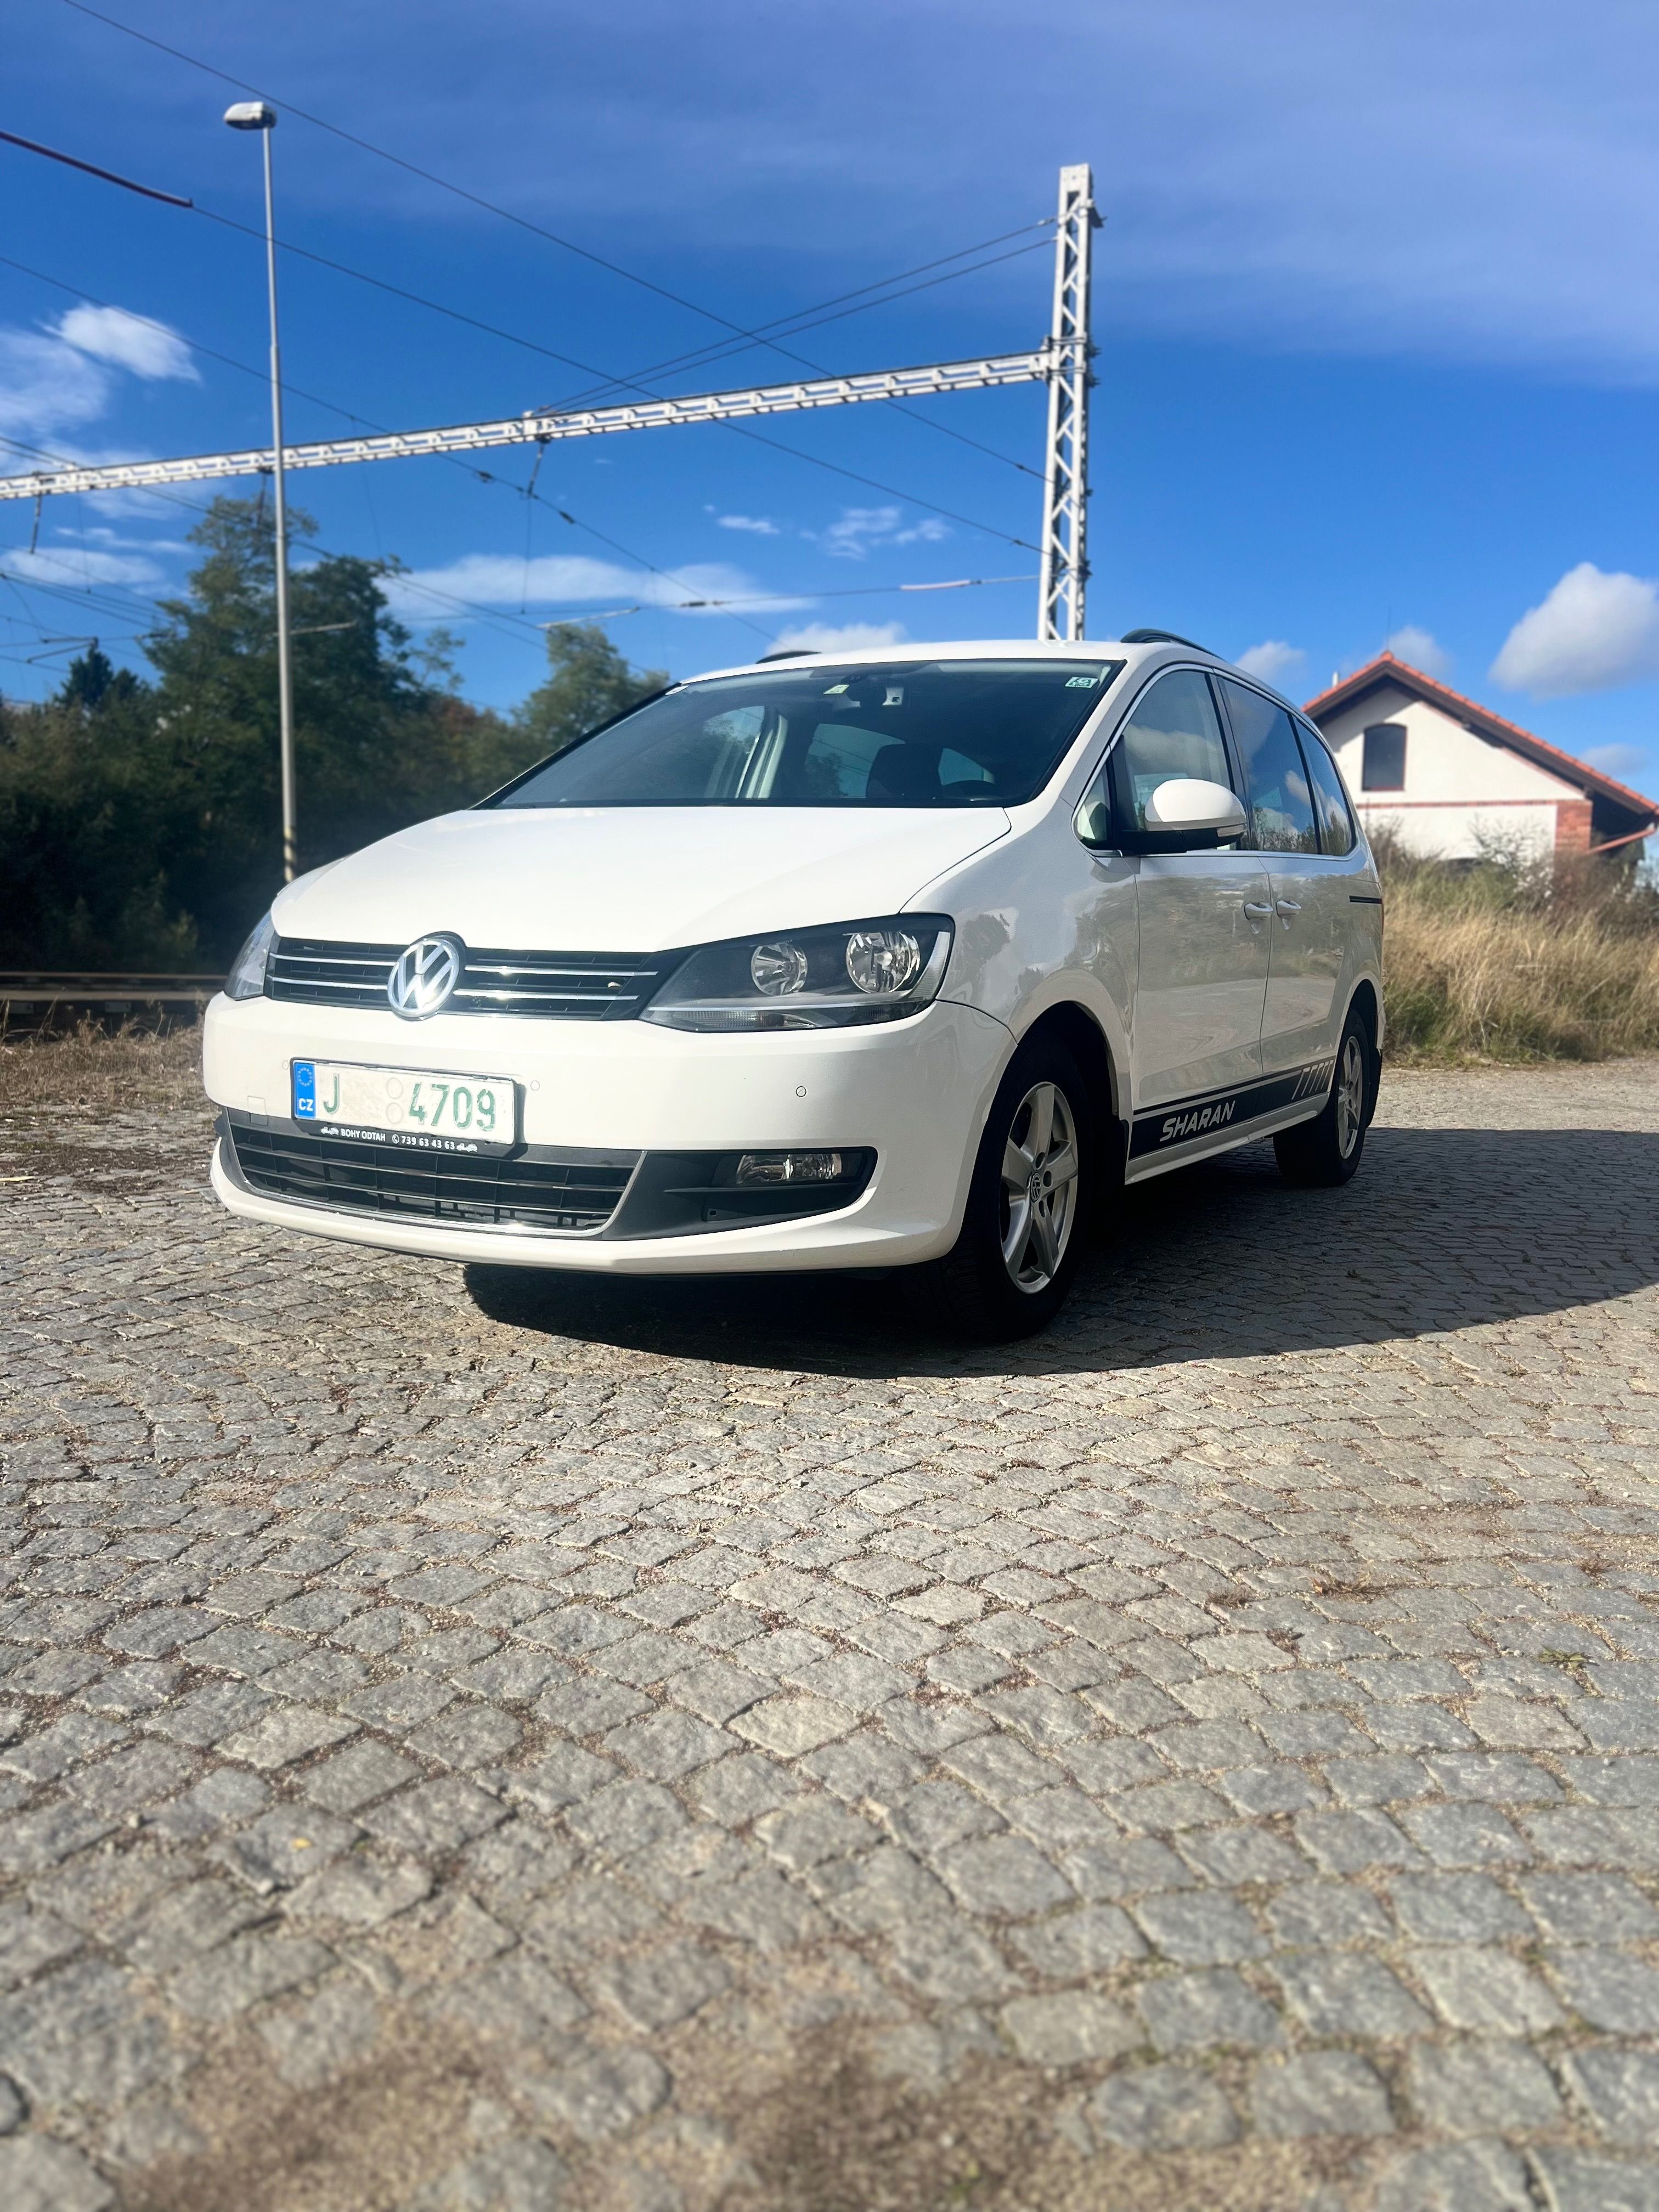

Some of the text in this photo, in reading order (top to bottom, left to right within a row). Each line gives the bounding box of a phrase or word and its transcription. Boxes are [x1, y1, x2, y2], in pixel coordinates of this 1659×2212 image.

[390, 940, 458, 1013] VW
[298, 1098, 313, 1111] CZ
[408, 1082, 495, 1132] 4709
[1159, 1100, 1236, 1142] SHARAN
[341, 1128, 455, 1150] BOHY ODTAH 739 63 43 63
